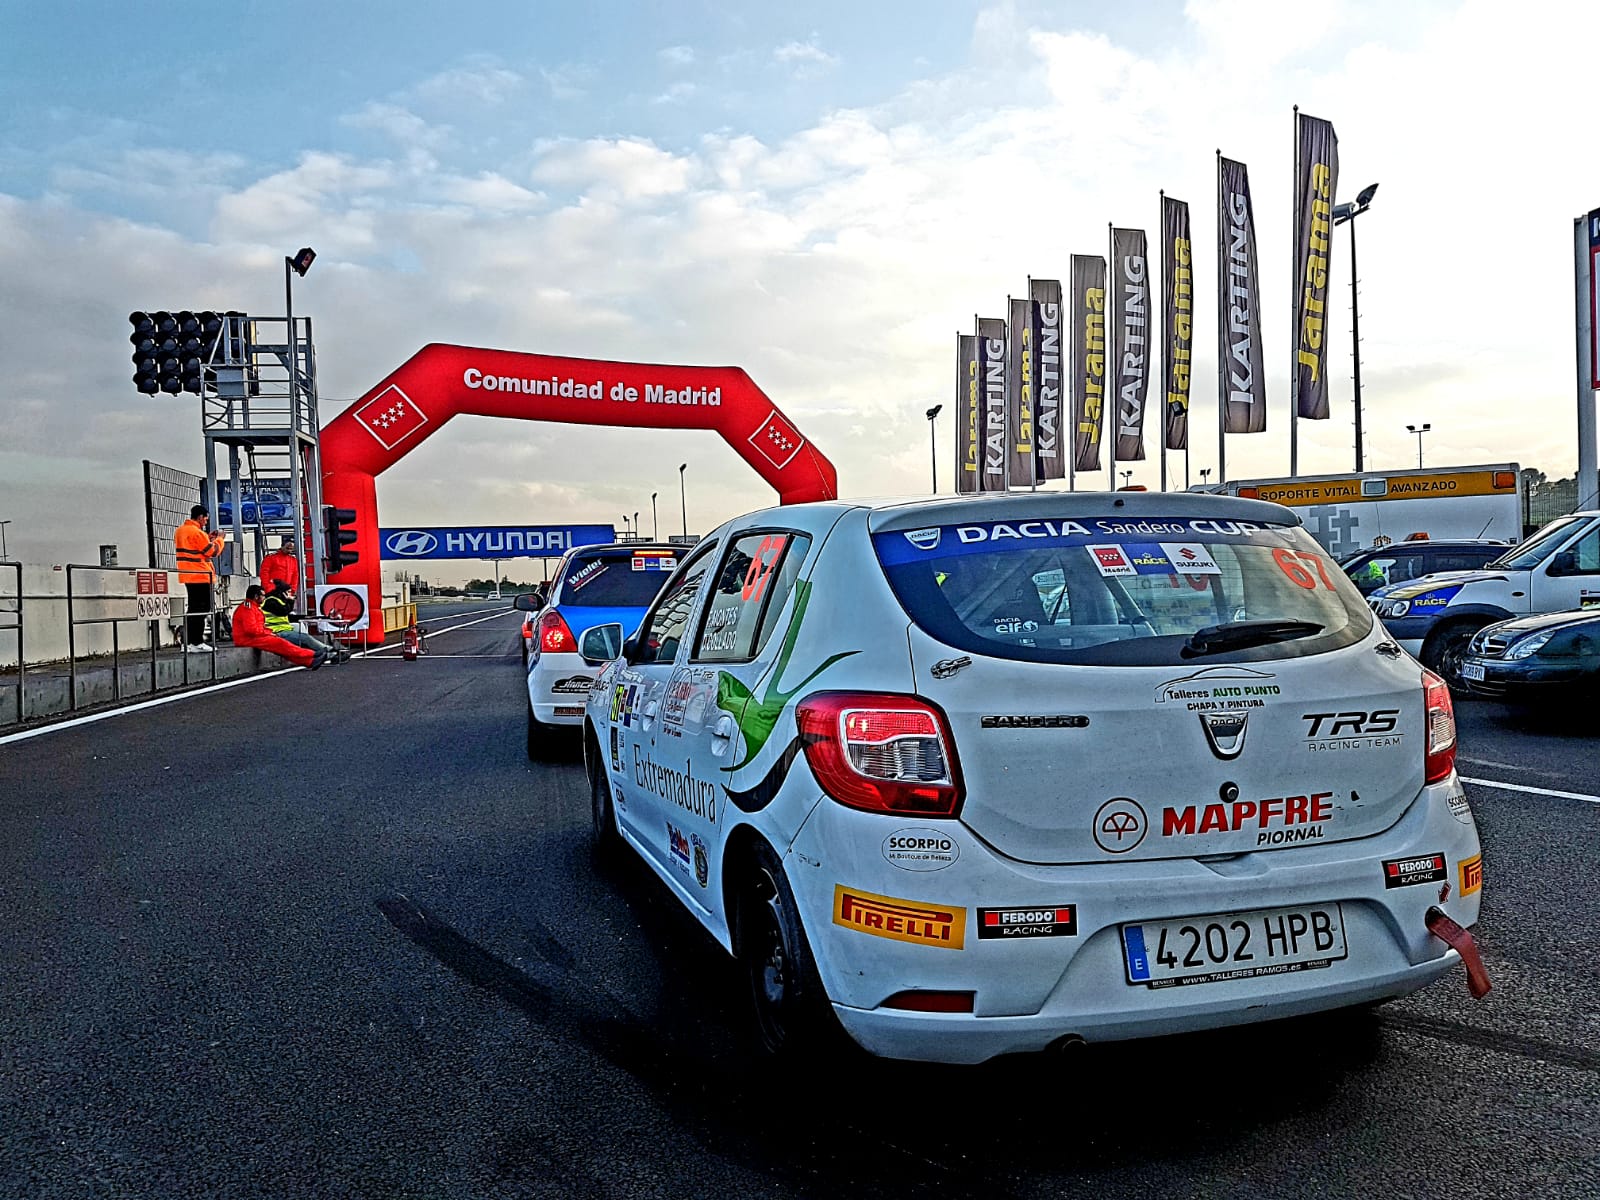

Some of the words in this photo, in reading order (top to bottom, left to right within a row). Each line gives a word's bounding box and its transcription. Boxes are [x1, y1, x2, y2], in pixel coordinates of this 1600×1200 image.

[1298, 162, 1331, 382] Jarama
[1230, 191, 1255, 404] KARTING
[1168, 236, 1191, 409] Jarama
[1120, 254, 1145, 437] KARTING
[1080, 287, 1105, 444] Jarama
[462, 367, 604, 401] Comunidad
[609, 381, 639, 403] de
[644, 383, 721, 406] Madrid
[1038, 302, 1058, 458] KARTING
[986, 337, 1006, 475] KARTING
[1260, 487, 1320, 501] SOPORTE
[1324, 485, 1358, 497] VITAL
[1390, 479, 1457, 493] AVANZADO
[447, 530, 573, 553] HYUNDAI
[957, 520, 1092, 544] DACIA
[1097, 520, 1186, 535] Sandero
[1189, 520, 1262, 537] CUP
[742, 536, 785, 603] 67
[1272, 548, 1336, 591] 67
[1415, 598, 1447, 606] RACE
[995, 622, 1022, 633] elf
[1167, 689, 1209, 700] Talleres
[1213, 687, 1241, 697] AUTO
[1244, 685, 1281, 696] PUNTO
[1187, 701, 1217, 711] CHAPA
[1219, 701, 1225, 709] Y
[1228, 699, 1265, 709] PINTURA
[982, 715, 1090, 728] SANDERO
[1210, 717, 1244, 726] DACIA
[1301, 709, 1401, 737] TRS
[1308, 740, 1360, 752] RACING
[1368, 738, 1401, 749] TEAM
[633, 743, 717, 824] Extremadura
[1162, 791, 1333, 837] MAPFRE
[889, 837, 952, 850] SCORPIO
[1256, 825, 1325, 846] PIORNAL
[1399, 859, 1432, 873] FERODO
[1401, 872, 1433, 883] RACING
[842, 893, 955, 942] PIRELLI
[1001, 910, 1055, 924] FERODO
[1002, 924, 1053, 935] RACING
[1155, 920, 1255, 970] 4202
[1264, 909, 1336, 957] HPB
[1135, 958, 1143, 970] E
